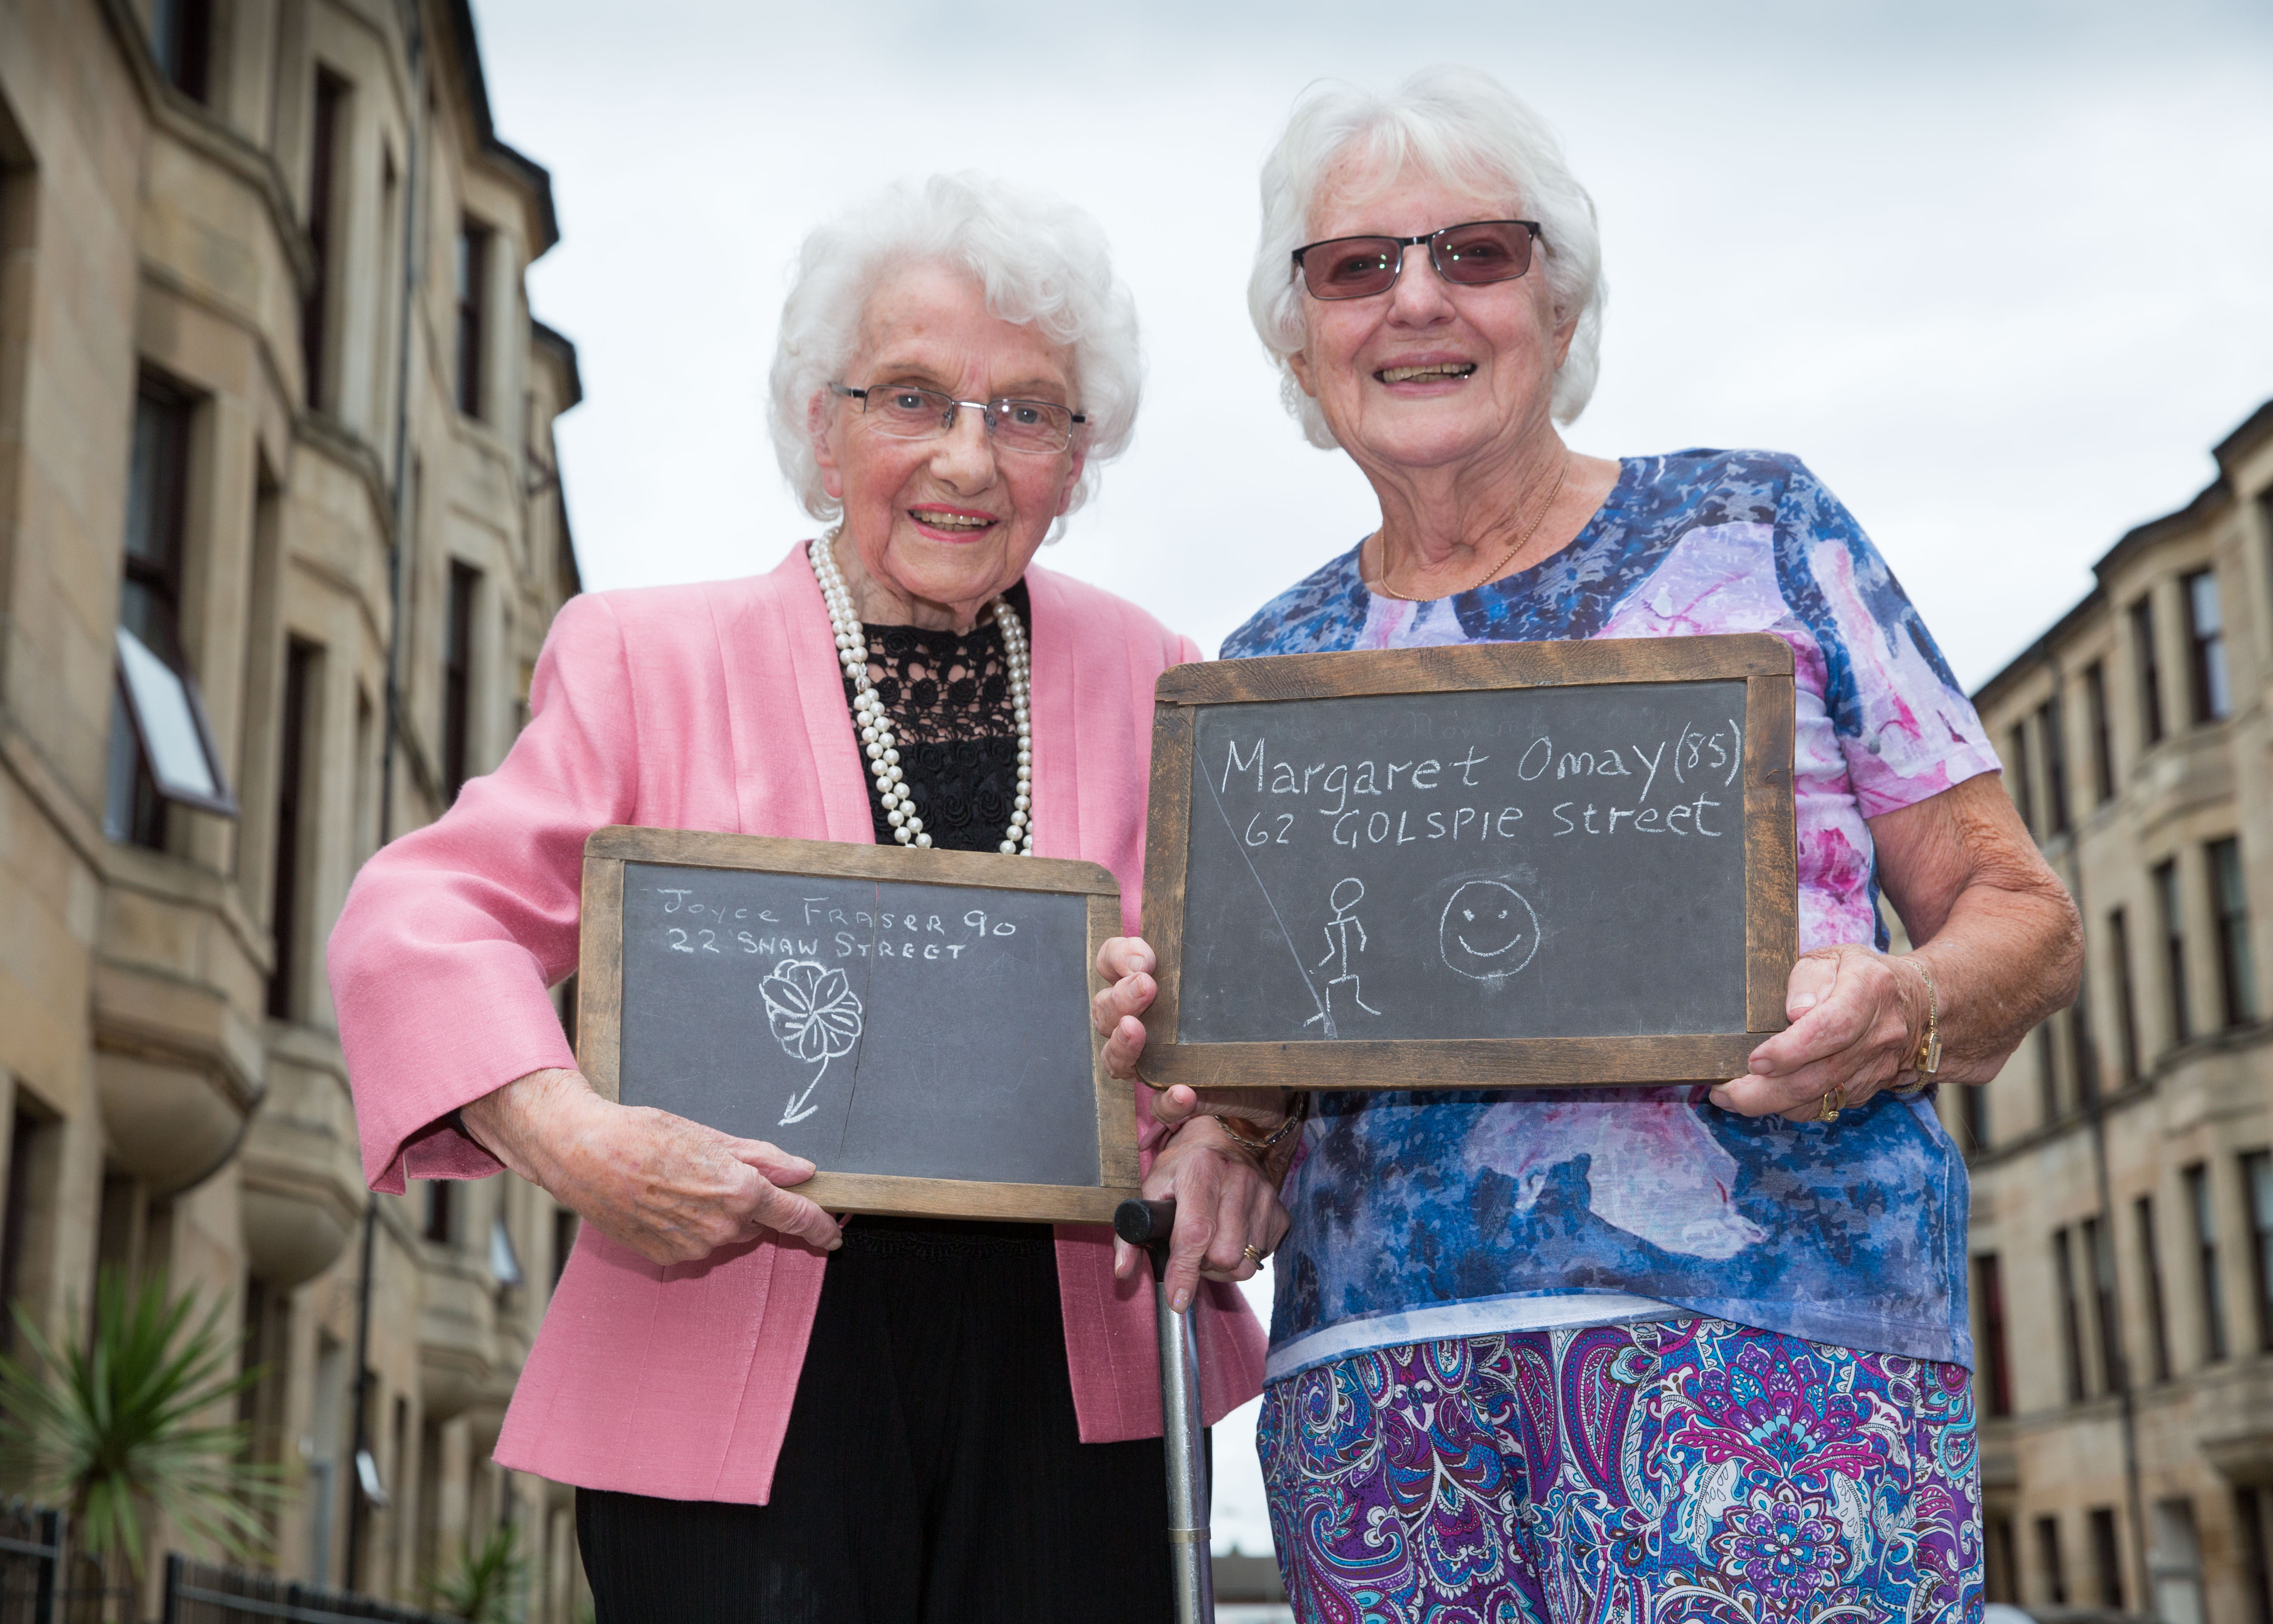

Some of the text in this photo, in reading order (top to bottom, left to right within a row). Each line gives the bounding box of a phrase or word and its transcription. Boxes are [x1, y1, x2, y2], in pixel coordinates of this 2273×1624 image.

[1220, 737, 1491, 815] Margaret
[1245, 812, 1295, 847] 62
[657, 888, 780, 923] Joyce
[964, 909, 1016, 938] 90
[666, 928, 720, 953] 22
